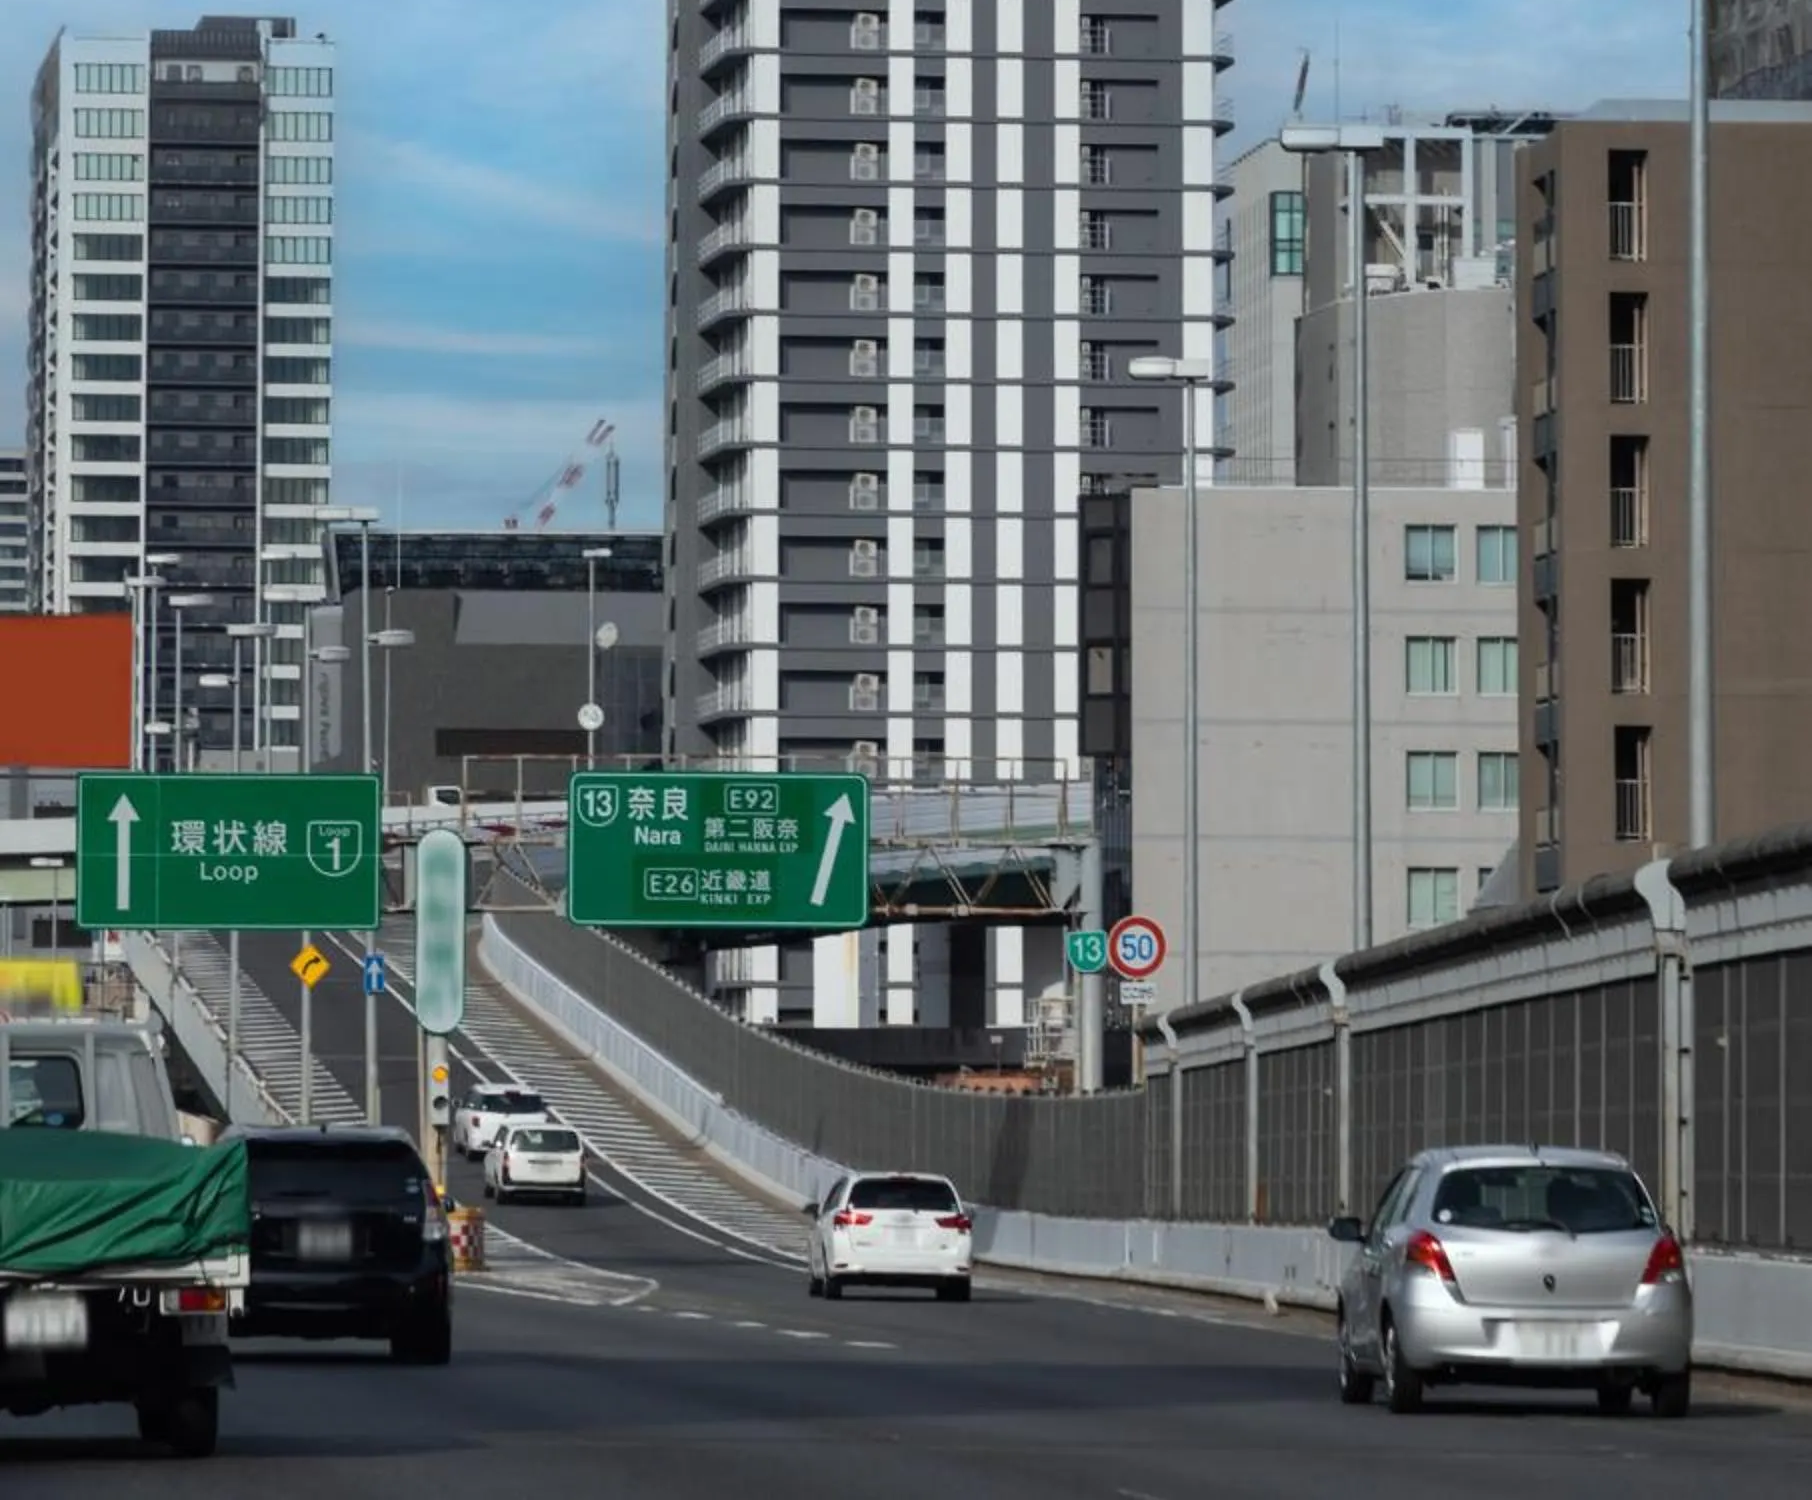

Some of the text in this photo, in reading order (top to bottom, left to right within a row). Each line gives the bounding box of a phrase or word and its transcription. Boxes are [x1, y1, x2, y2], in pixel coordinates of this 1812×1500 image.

[585, 790, 612, 817] 13
[627, 786, 689, 821] 奈良
[729, 789, 774, 810] E92
[170, 819, 288, 856] 環状線
[319, 825, 351, 838] Loop
[634, 825, 682, 846] Nara
[704, 818, 799, 840] 第二阪奈
[325, 837, 340, 870] 1
[200, 862, 259, 884] Loop
[650, 874, 695, 895] E26
[701, 869, 772, 892] 近畿道
[1074, 937, 1102, 962] 13
[1121, 934, 1153, 961] 50
